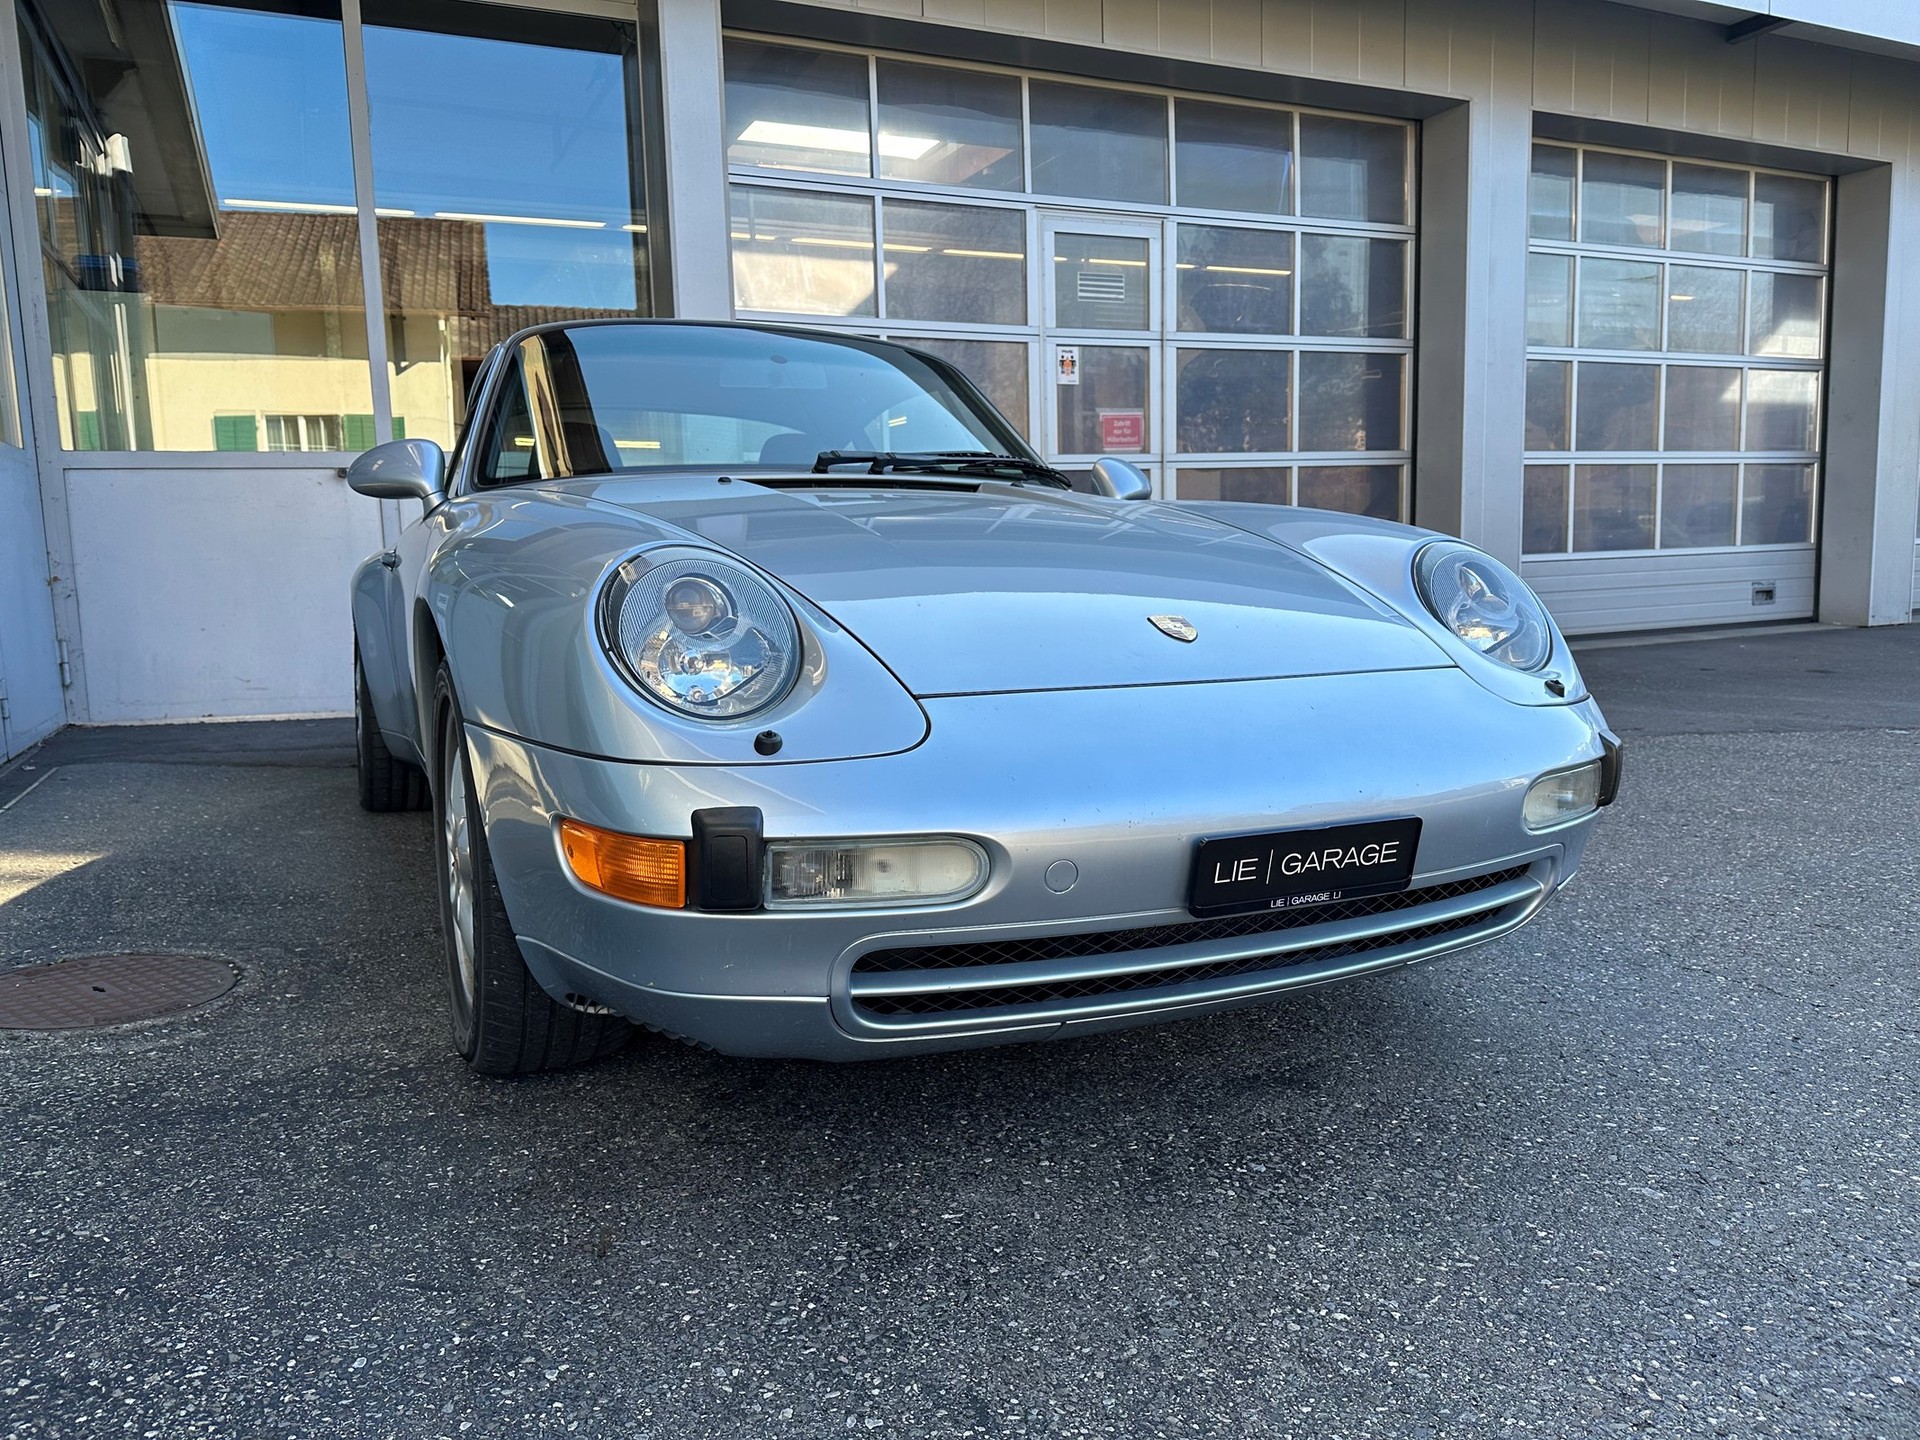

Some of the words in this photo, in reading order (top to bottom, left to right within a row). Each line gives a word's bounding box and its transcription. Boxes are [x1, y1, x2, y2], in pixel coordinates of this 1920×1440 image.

[1214, 858, 1259, 884] LIE
[1281, 841, 1400, 876] GARAGE
[1270, 898, 1285, 908] LIE
